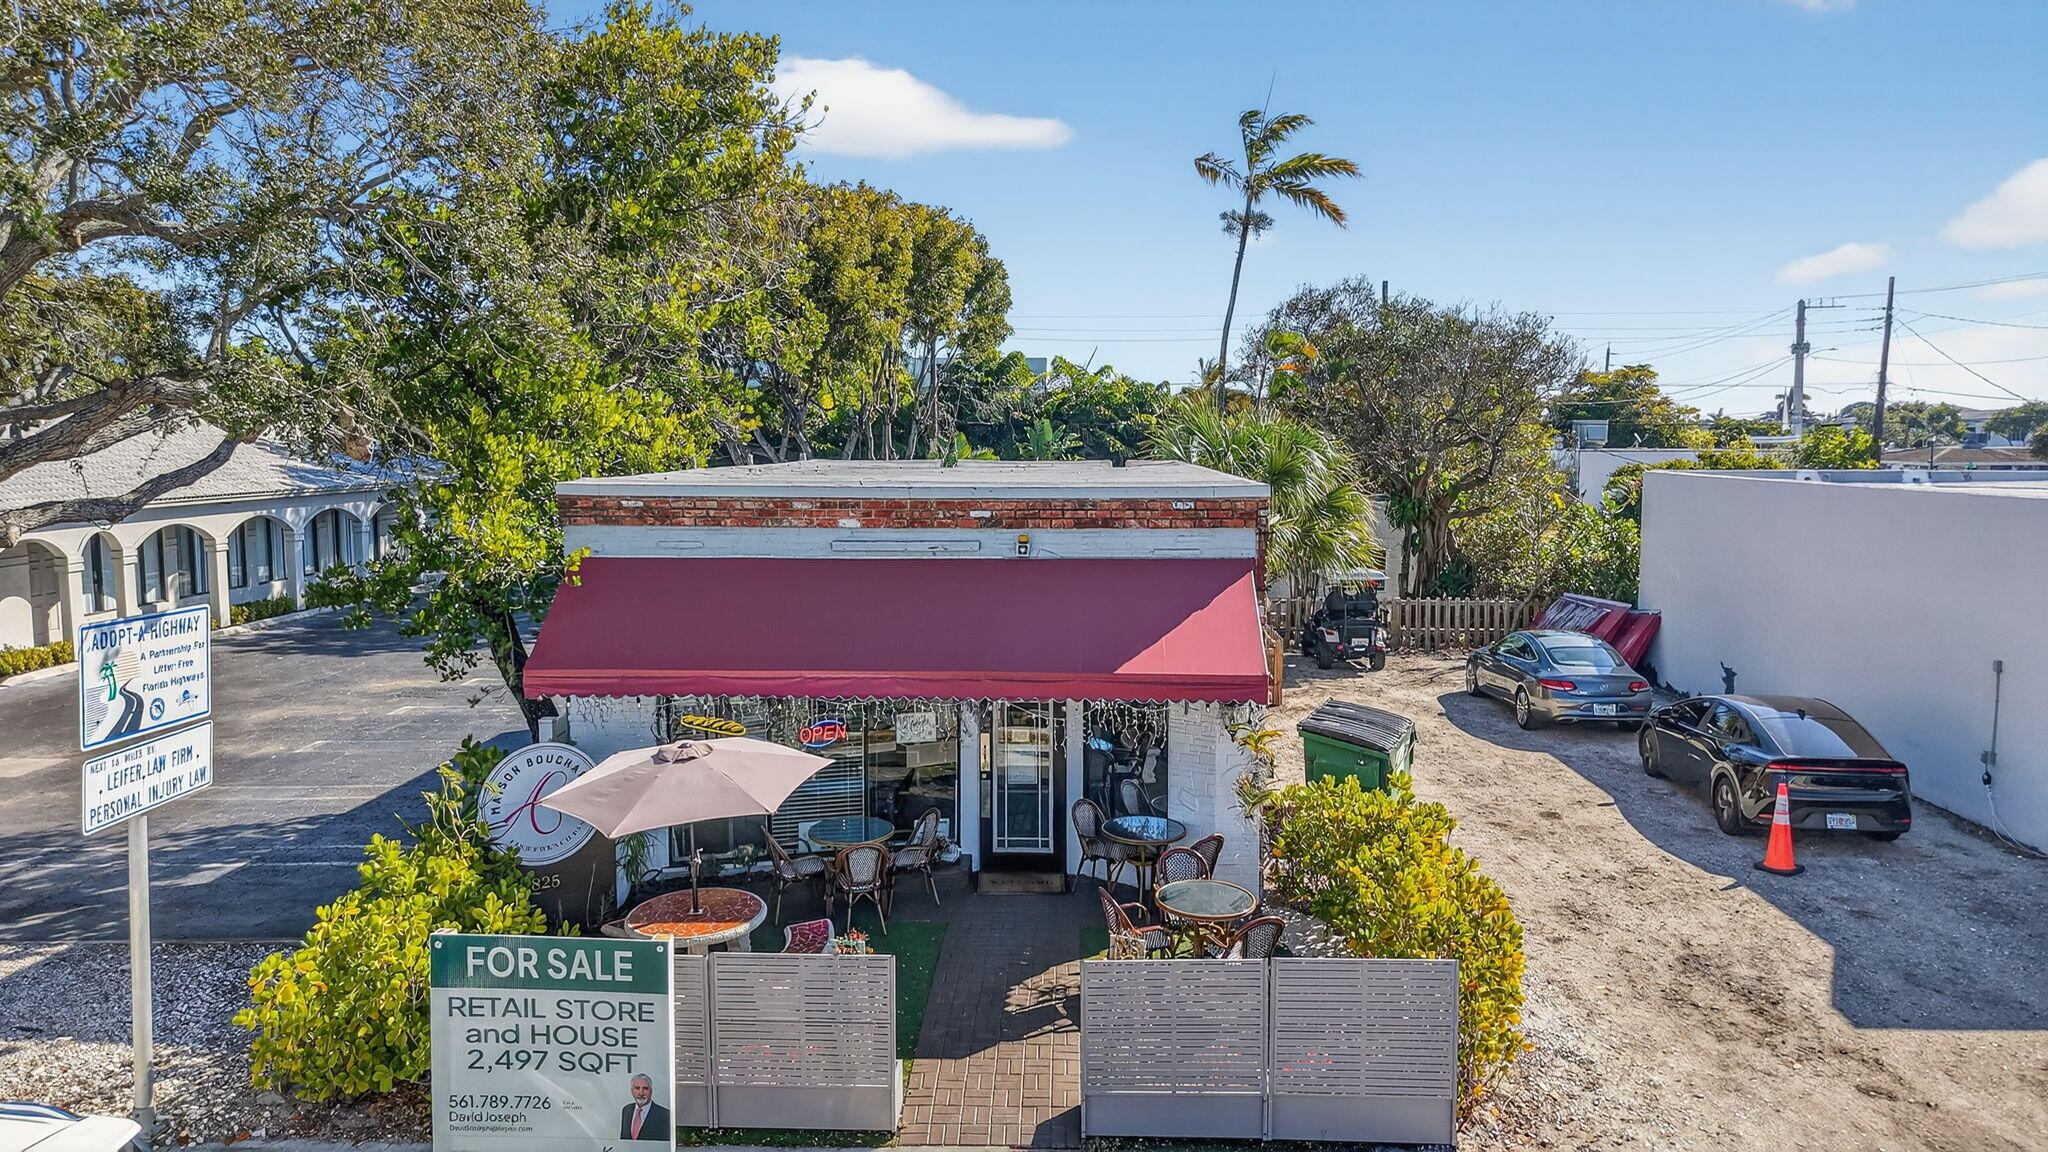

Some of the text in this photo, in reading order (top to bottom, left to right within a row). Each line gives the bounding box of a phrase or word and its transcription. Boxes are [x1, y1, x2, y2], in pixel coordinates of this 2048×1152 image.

[92, 615, 200, 651] ADOPT-A-HIGHWAY
[140, 652, 147, 661] A
[177, 659, 194, 669] Free
[170, 674, 205, 689] Highways
[800, 723, 846, 743] OPEN
[90, 761, 107, 774] NEXT
[147, 755, 166, 776] LAW
[172, 745, 193, 767] FIRM
[90, 766, 208, 826] PERSONAL INJURY LAW
[531, 874, 561, 891] 825
[466, 946, 633, 982] FOR SALE
[448, 996, 655, 1022] RETAIL STORE
[466, 1023, 638, 1048] and HOUSE
[467, 1049, 637, 1075] 2,497 SQFT
[449, 1094, 551, 1110] 561.789.7726
[449, 1111, 527, 1126] David Joseph
